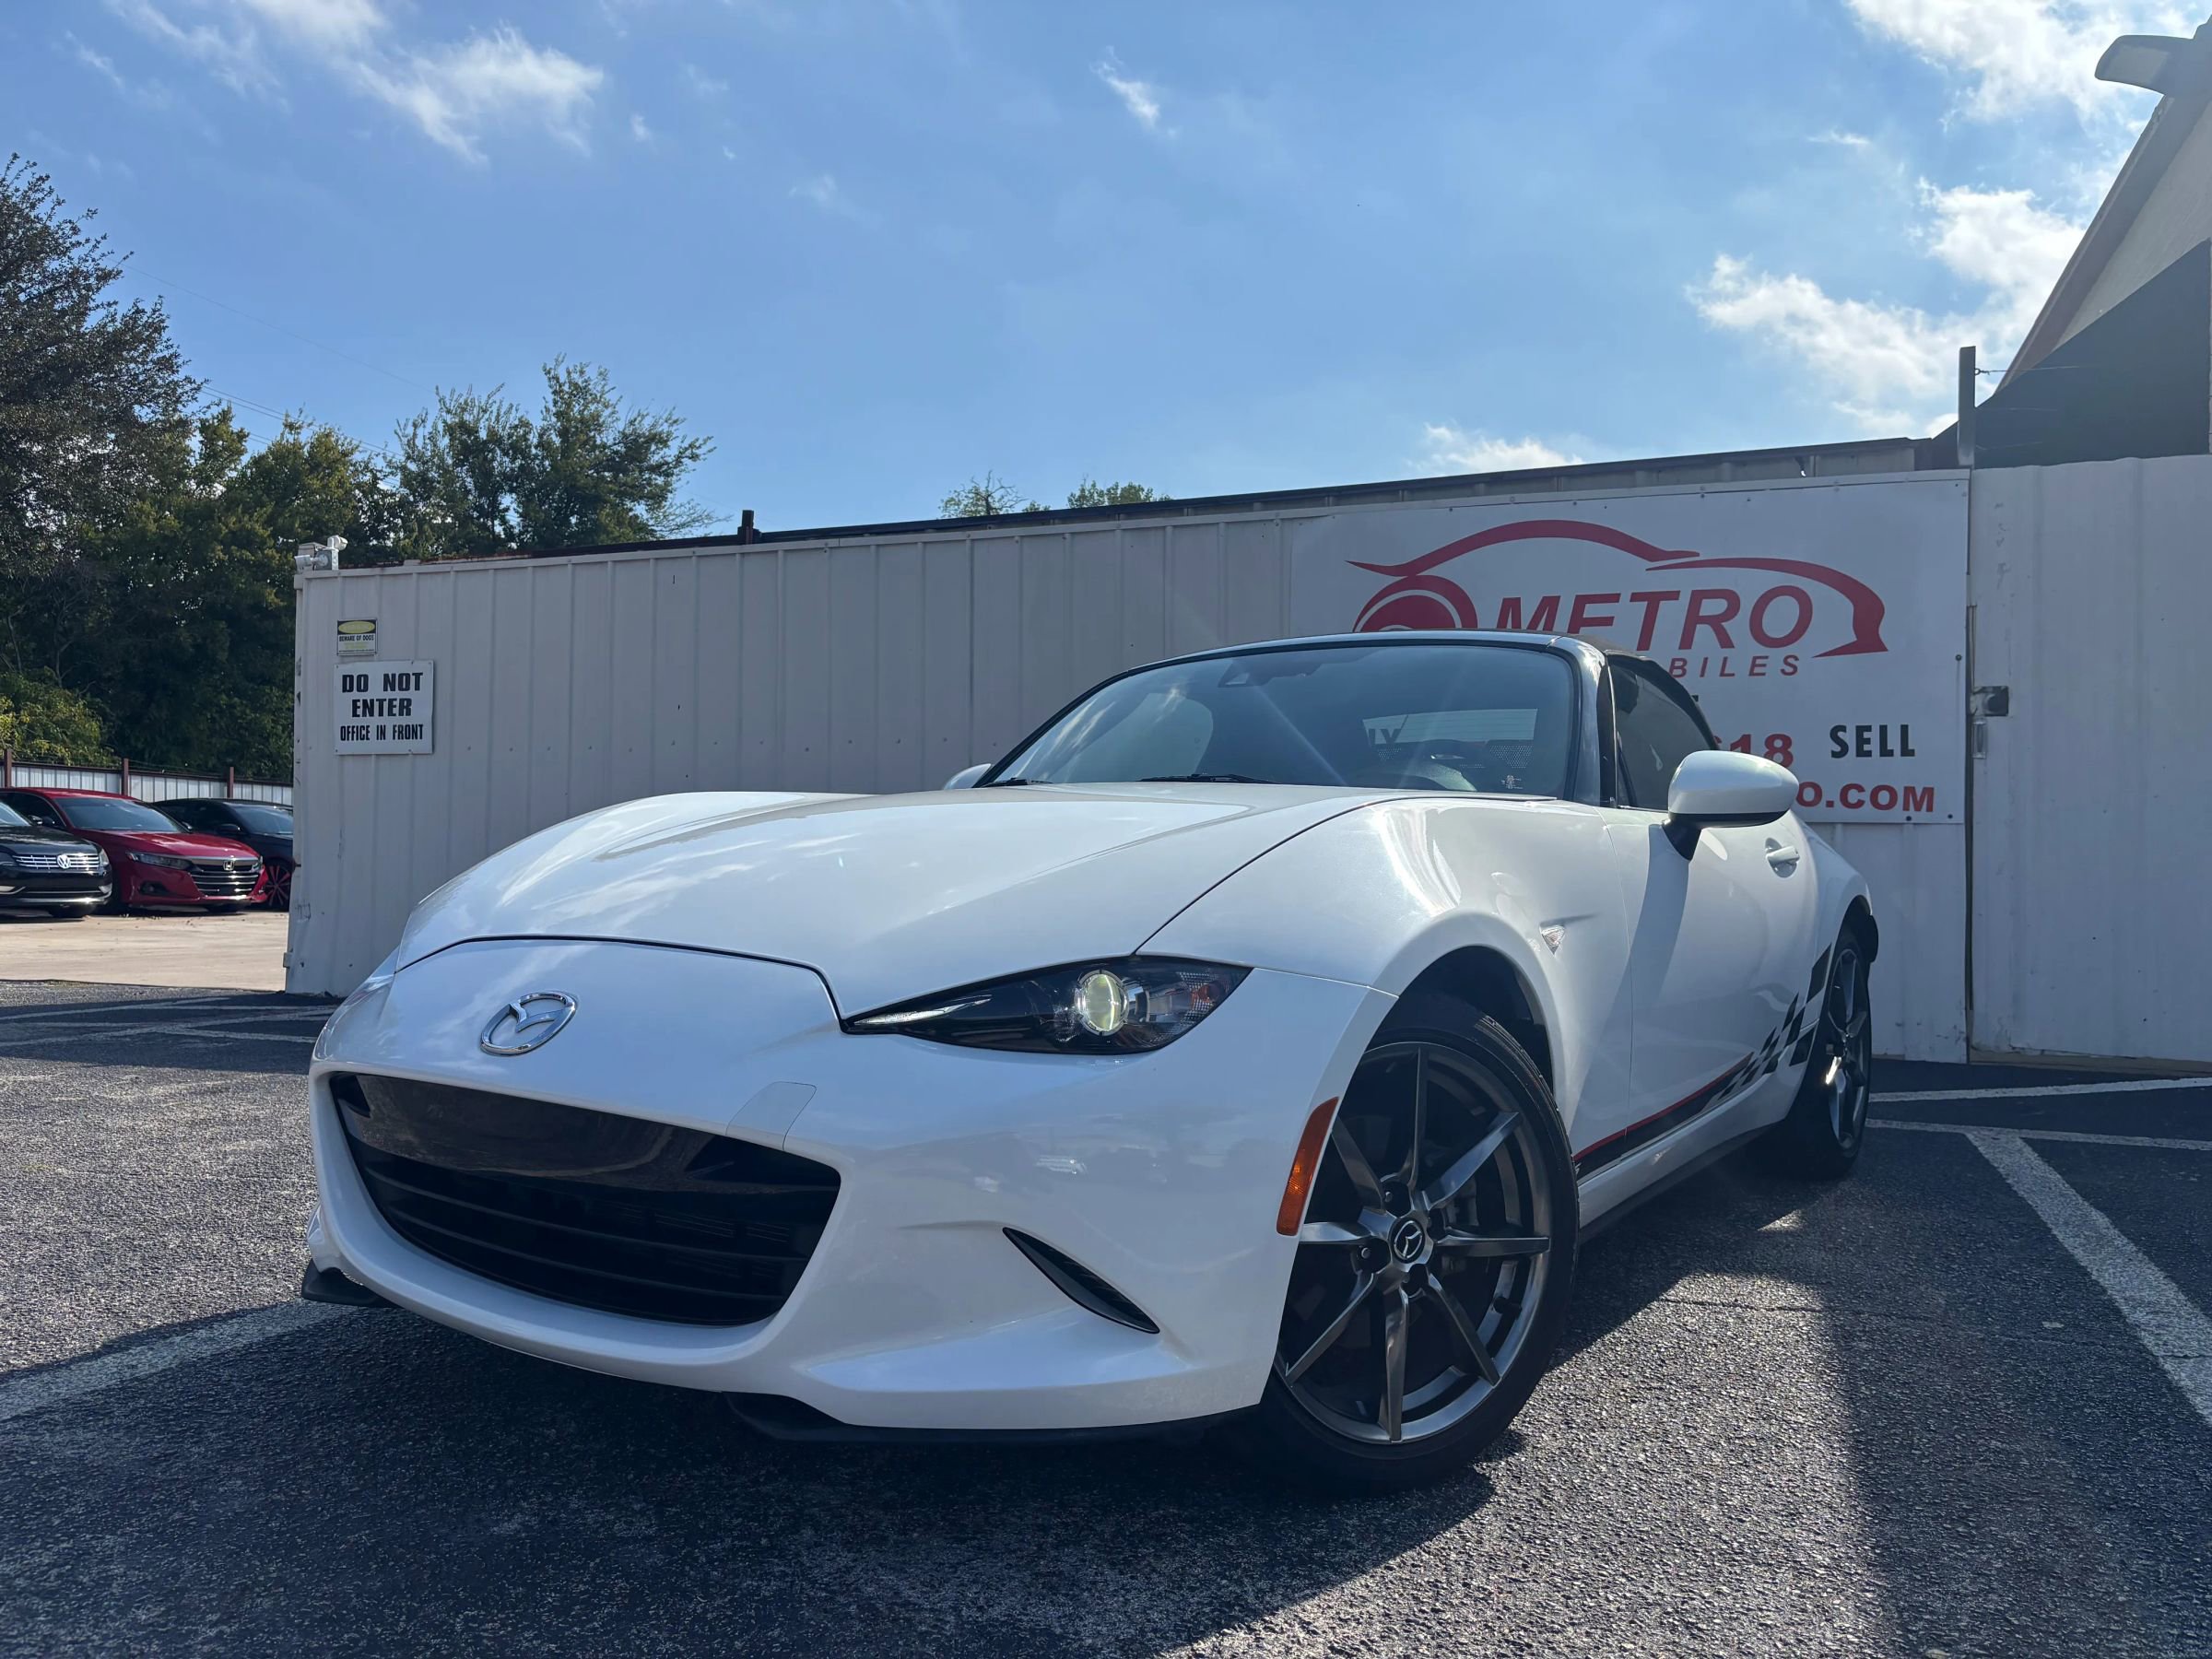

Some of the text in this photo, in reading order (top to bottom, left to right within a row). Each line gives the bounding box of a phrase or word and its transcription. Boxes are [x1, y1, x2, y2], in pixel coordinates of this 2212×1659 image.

[1496, 585, 1813, 652] METRO
[342, 673, 423, 693] DO NOT
[352, 698, 412, 717] ENTER
[340, 724, 424, 741] OFFICE IN FRONT
[1830, 724, 1915, 759] SELL
[1713, 734, 1794, 768] 18
